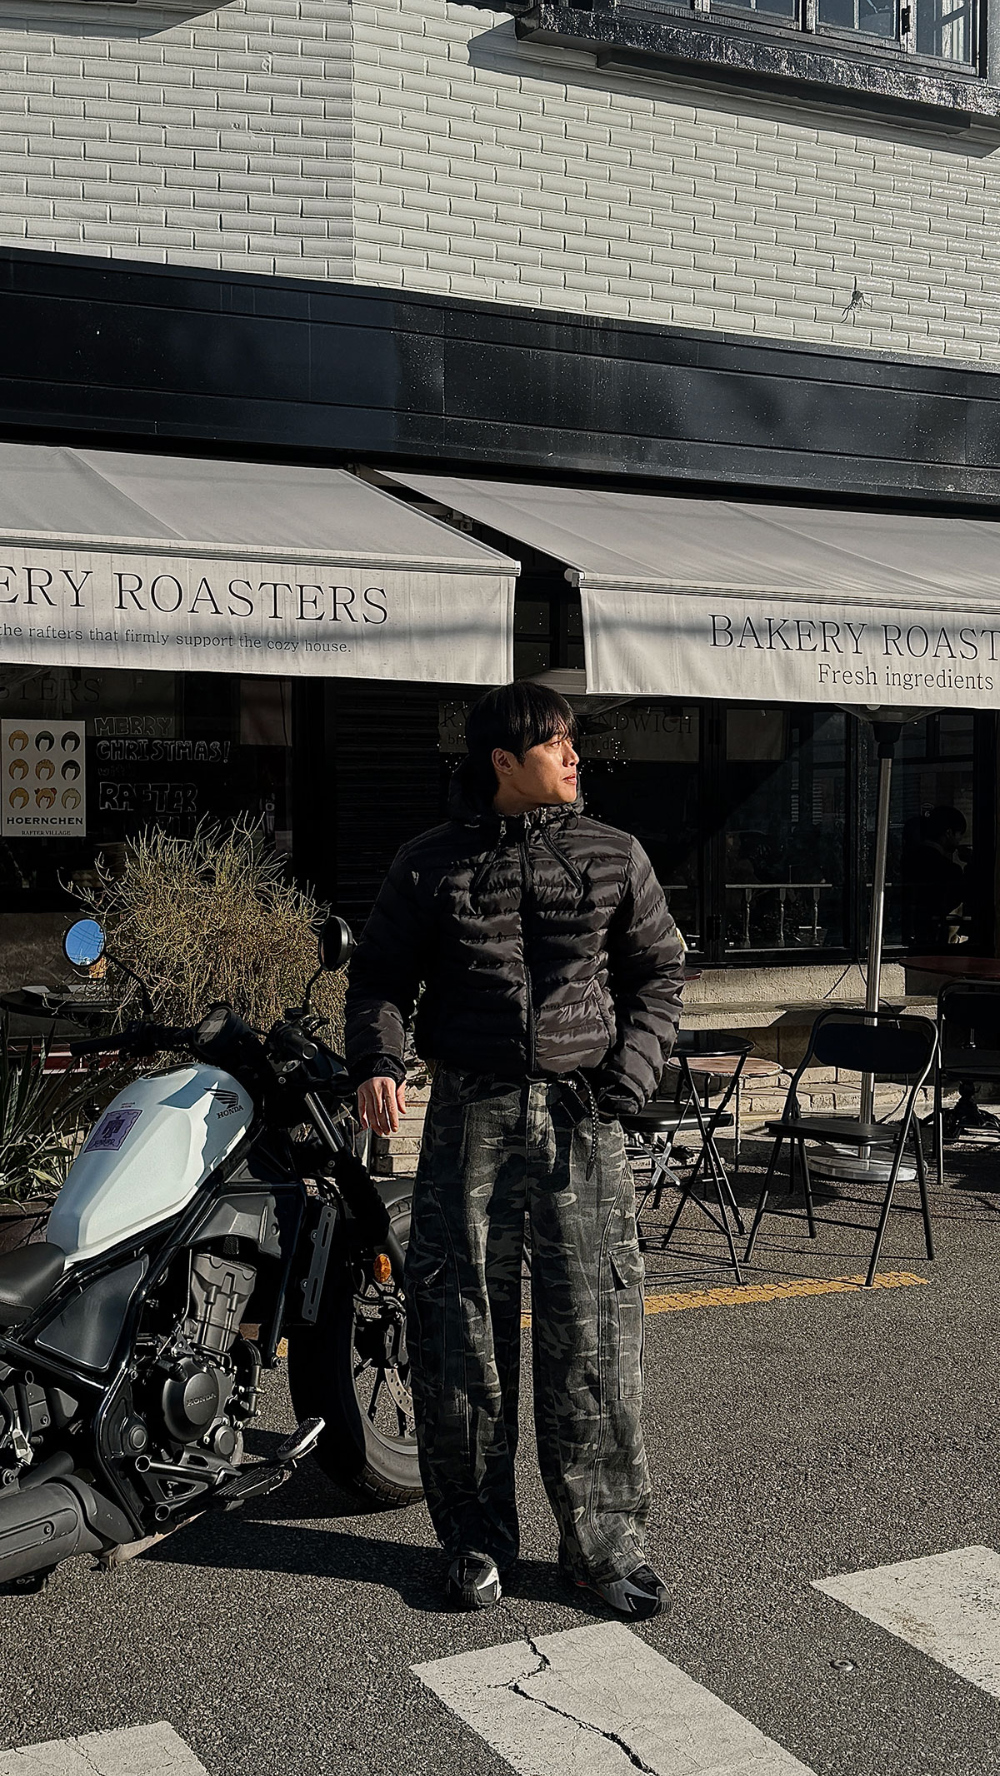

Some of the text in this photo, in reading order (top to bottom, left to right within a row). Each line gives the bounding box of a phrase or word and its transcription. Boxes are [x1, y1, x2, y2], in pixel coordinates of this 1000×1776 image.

[0, 565, 389, 625] ERY ROASTERS
[28, 625, 83, 641] rafters
[89, 627, 119, 642] that
[125, 629, 170, 646] firmly
[176, 633, 234, 649] support
[239, 634, 262, 649] the
[267, 639, 299, 653] cozy
[305, 639, 352, 653] house.
[708, 614, 1000, 662] BAKERY ROAST
[818, 663, 994, 690] Fresh ingredients
[94, 716, 174, 737] MERRY
[96, 739, 231, 764] CHRISTMAS!
[99, 781, 199, 813] RAFTER
[7, 817, 83, 825] HOERNCHEN
[217, 1104, 244, 1119] HONDA
[186, 1392, 217, 1407] HONDA
